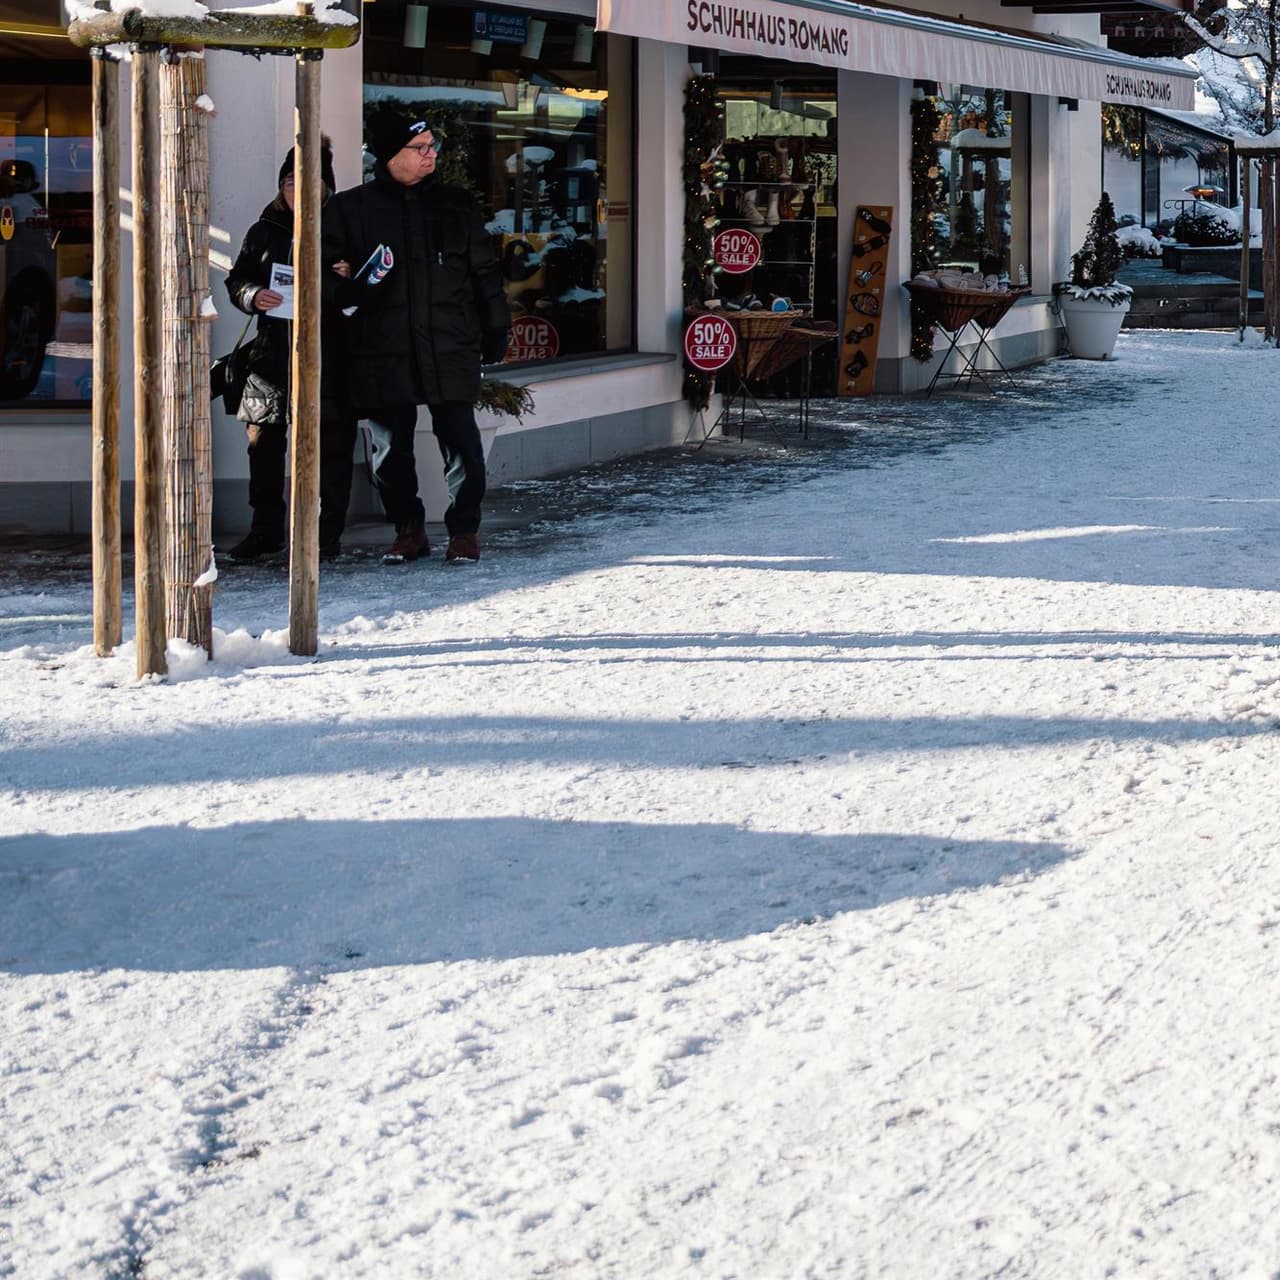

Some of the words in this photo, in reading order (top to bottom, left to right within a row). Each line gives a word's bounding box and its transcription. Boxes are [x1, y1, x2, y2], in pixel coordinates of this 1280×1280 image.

[687, 0, 786, 46] SCHUHHAUS
[789, 18, 849, 56] ROMANG
[1106, 73, 1146, 98] SCHUHHAUS
[1146, 80, 1172, 101] ROMANG
[721, 235, 755, 253] 50%
[721, 254, 750, 264] SALE
[694, 322, 730, 345] 50%
[695, 346, 725, 358] SALE
